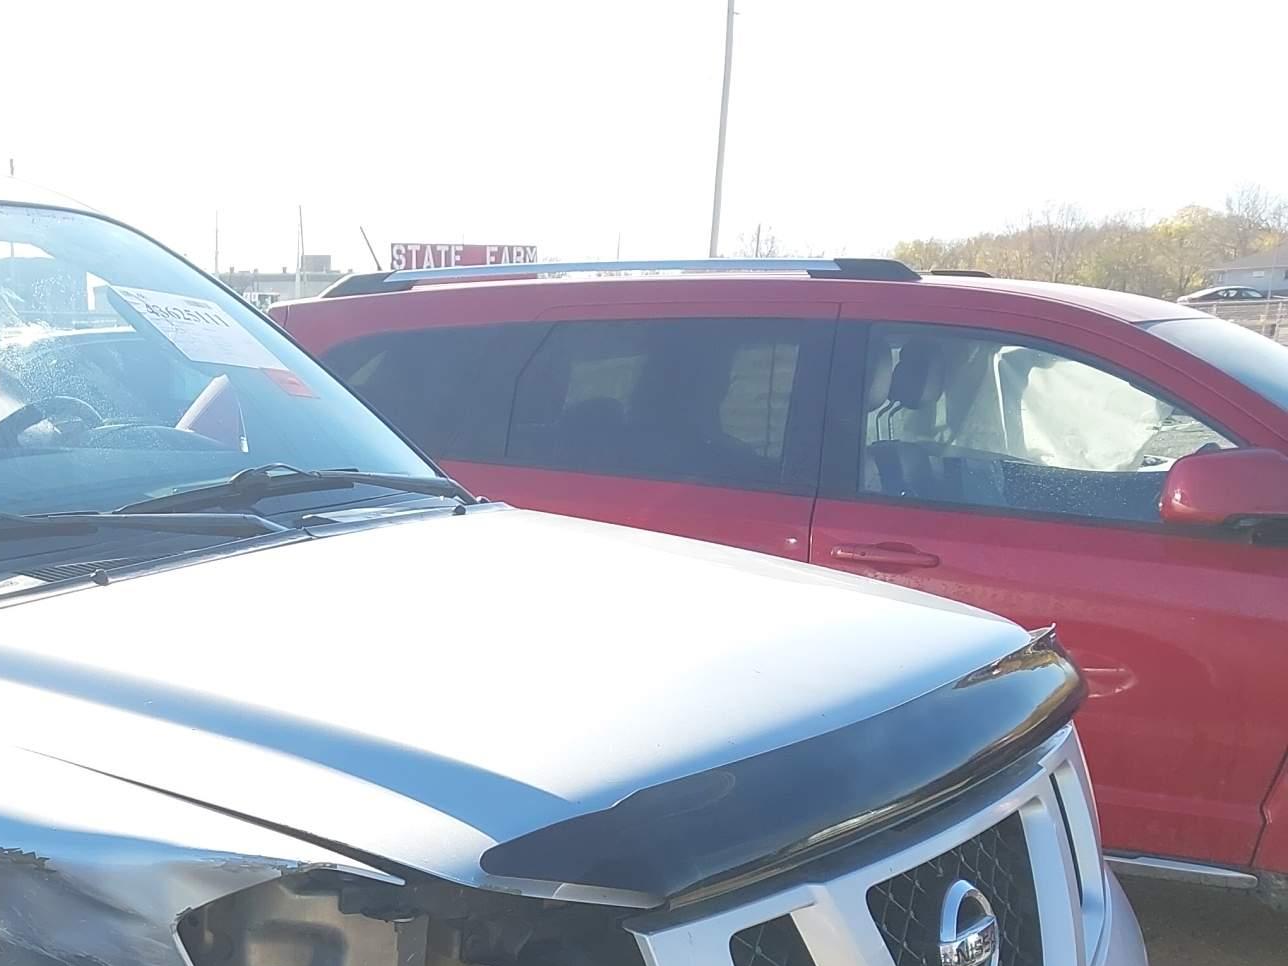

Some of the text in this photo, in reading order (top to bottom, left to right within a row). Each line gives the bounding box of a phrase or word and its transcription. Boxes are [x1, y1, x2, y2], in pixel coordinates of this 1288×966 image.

[392, 244, 538, 270] STATE FARM
[146, 303, 230, 327] 43625111
